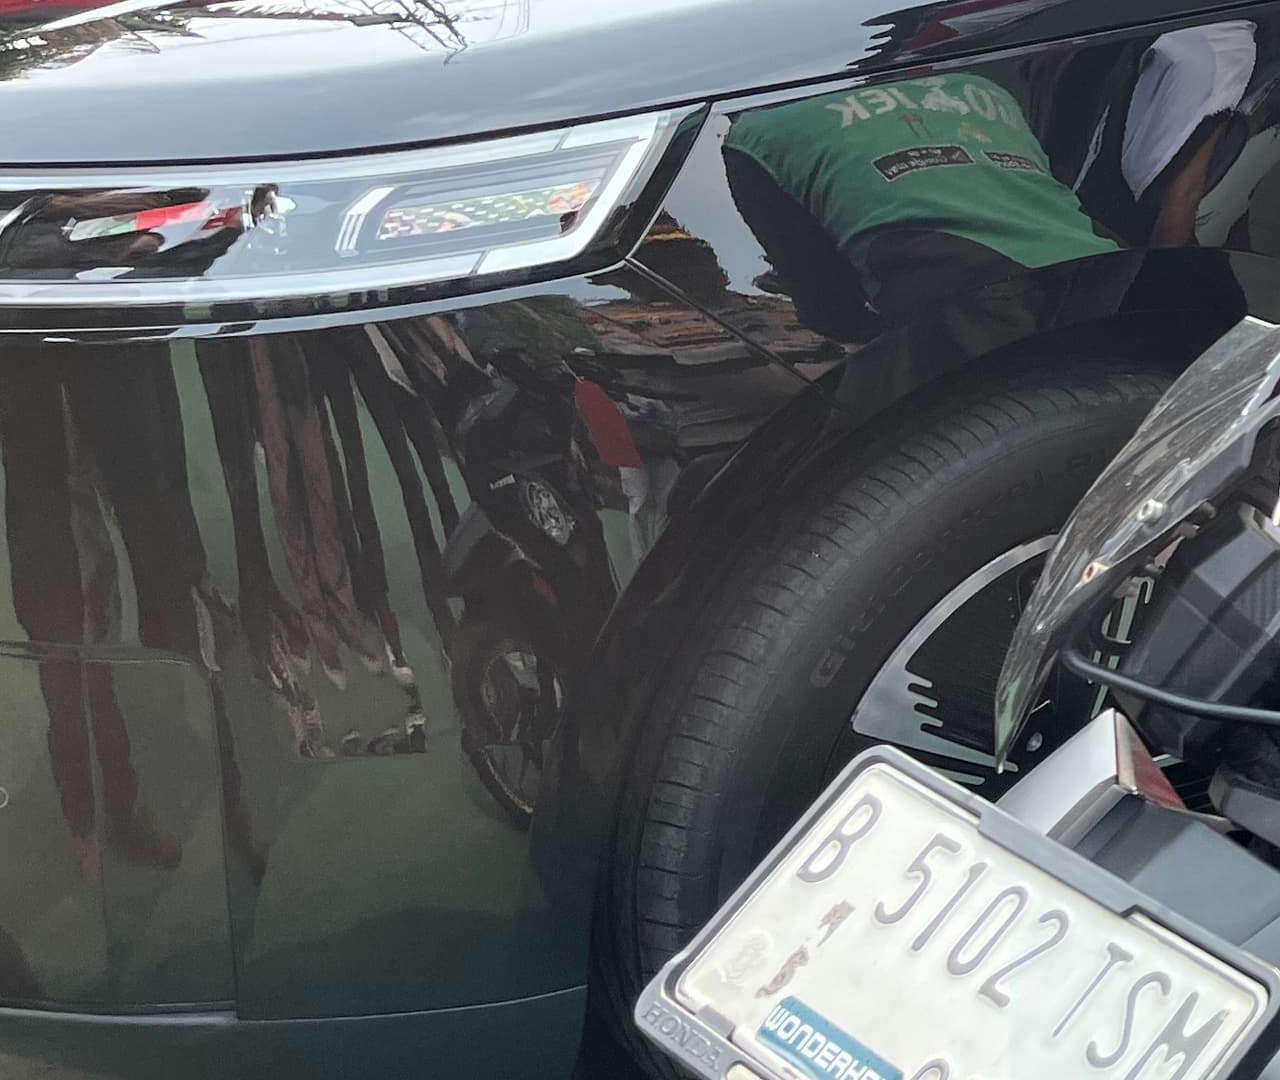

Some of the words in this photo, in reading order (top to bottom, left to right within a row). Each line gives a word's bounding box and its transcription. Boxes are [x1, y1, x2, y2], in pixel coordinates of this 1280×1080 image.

[796, 792, 884, 884] B
[873, 831, 1070, 1009] 5102
[1052, 941, 1233, 1080] TSM
[642, 1000, 724, 1072] HONDA
